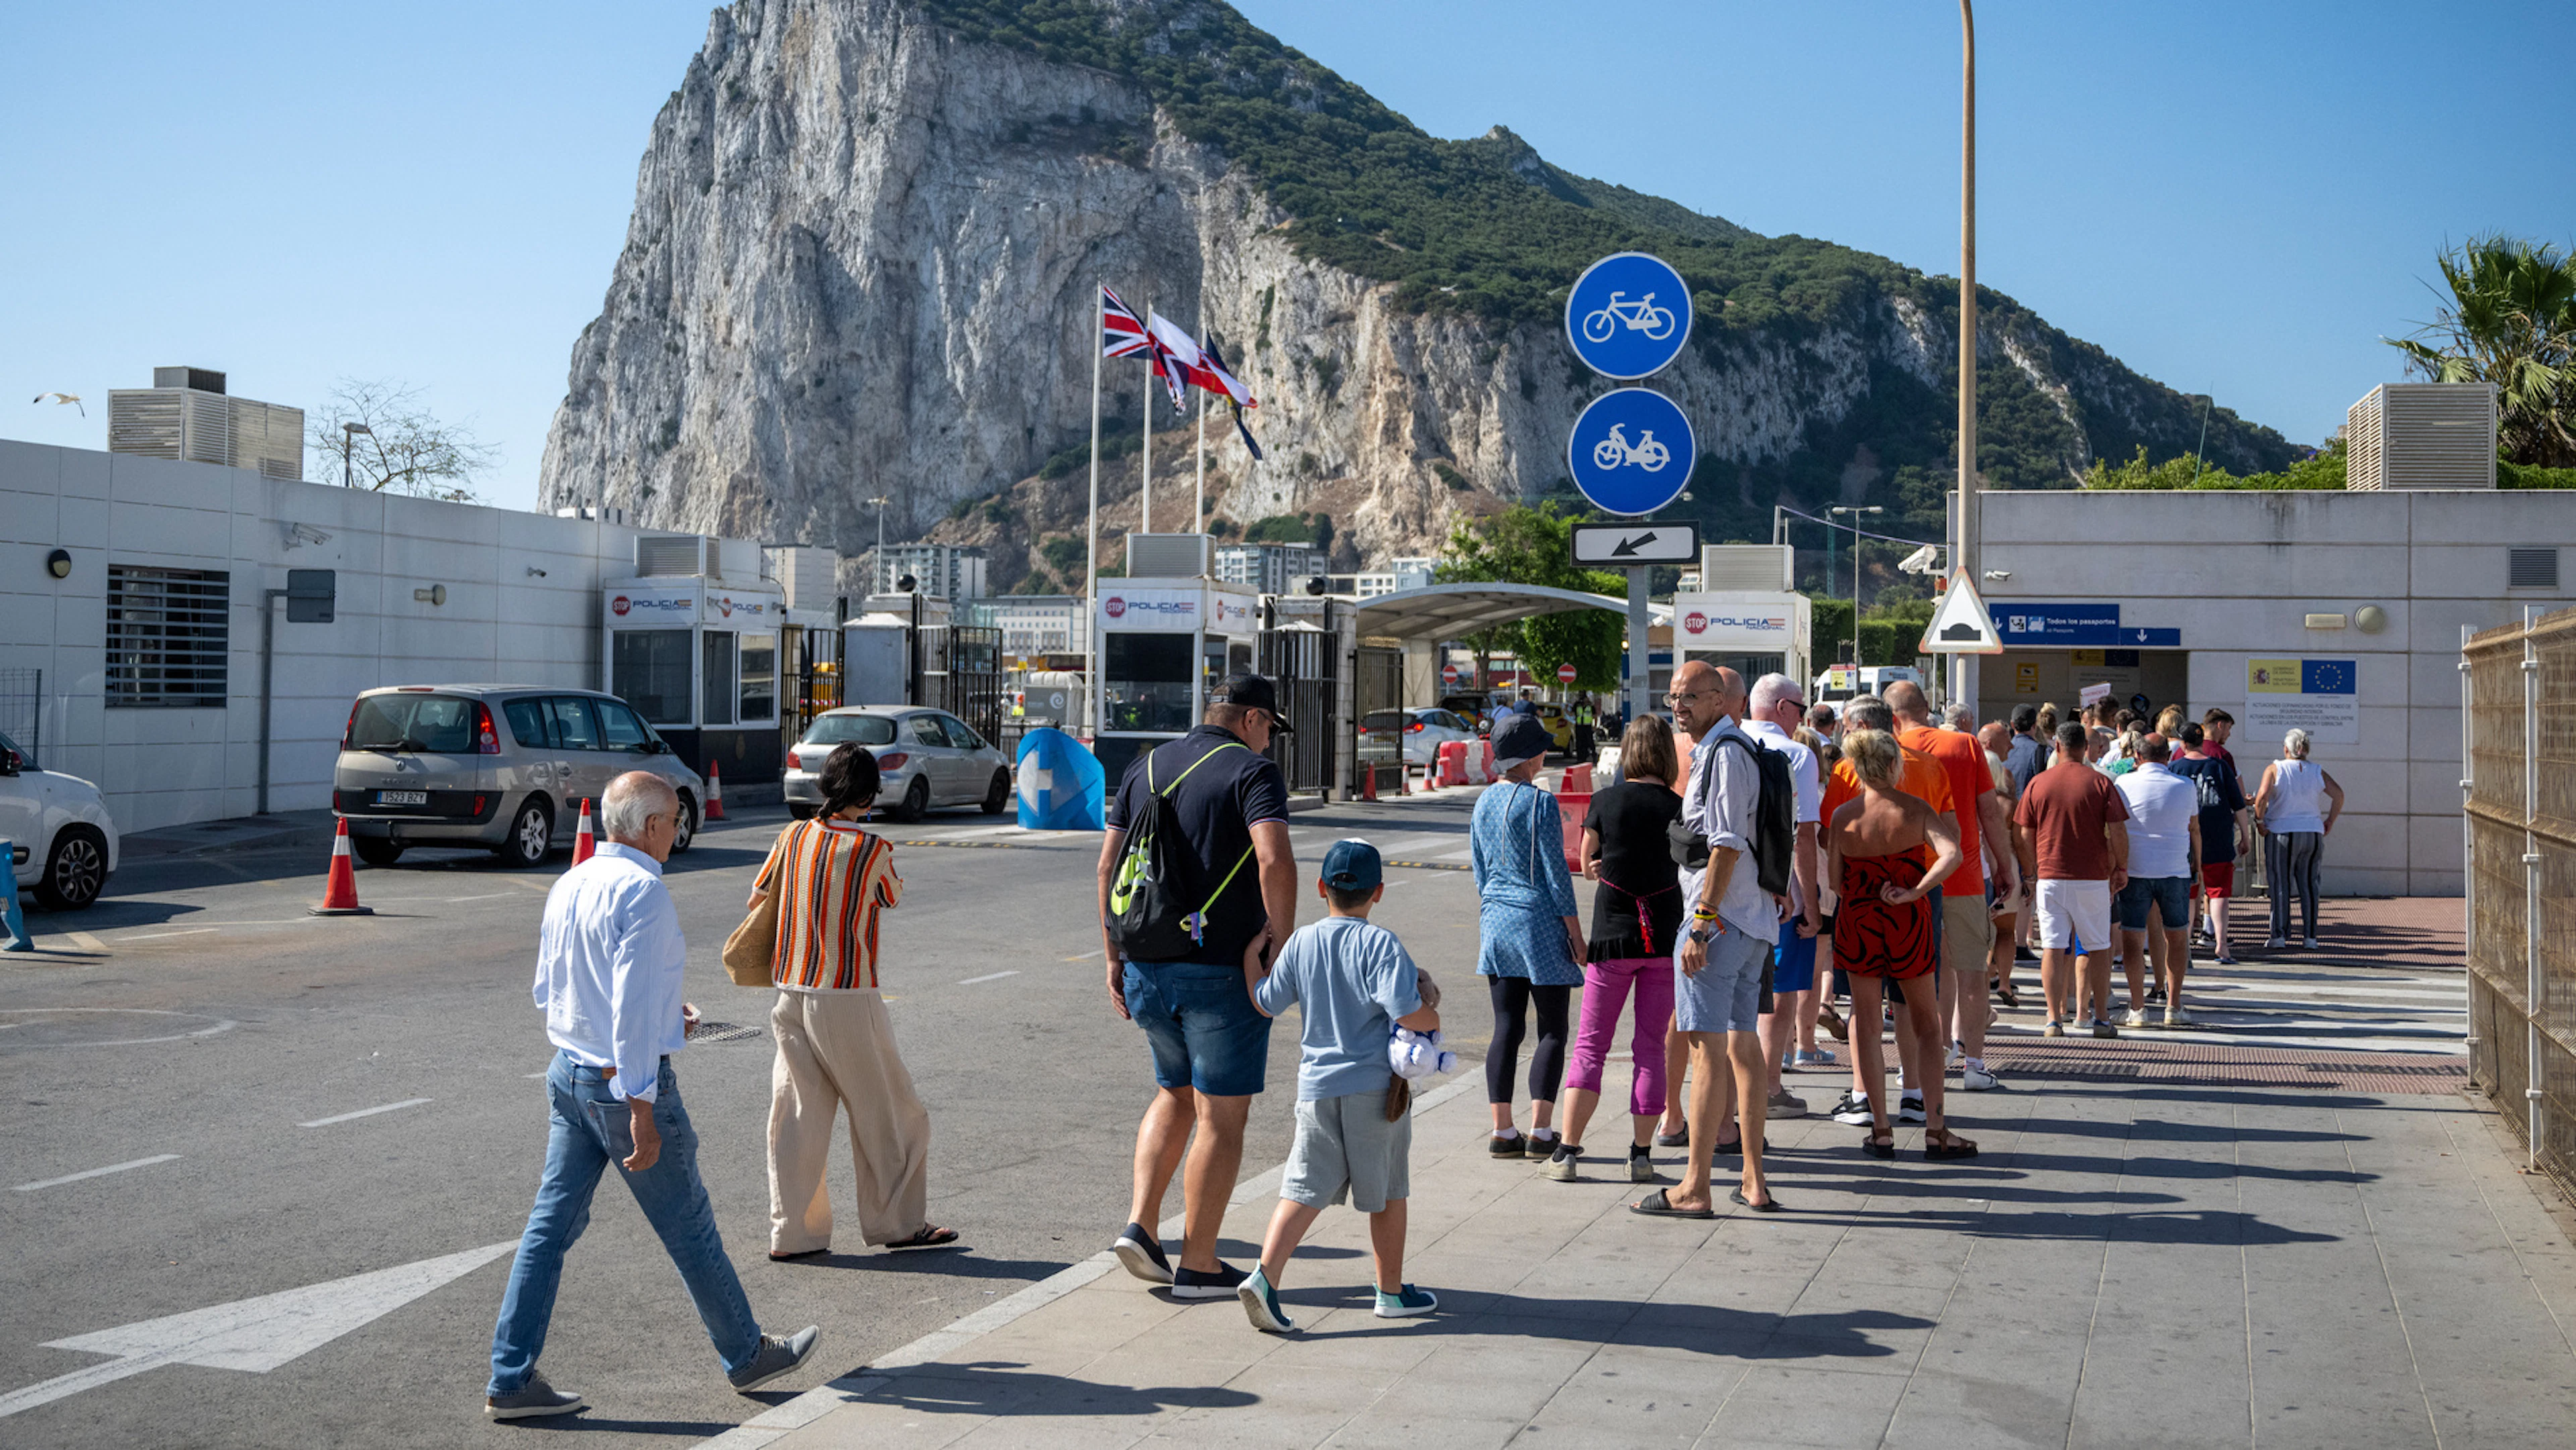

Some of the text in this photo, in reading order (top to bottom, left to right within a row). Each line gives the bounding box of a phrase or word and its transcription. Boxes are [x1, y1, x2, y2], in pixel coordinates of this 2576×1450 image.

[613, 601, 629, 611] STOP
[1107, 603, 1125, 612] STOP
[1686, 618, 1707, 629] STOP
[386, 792, 425, 803] 1523 BZY
